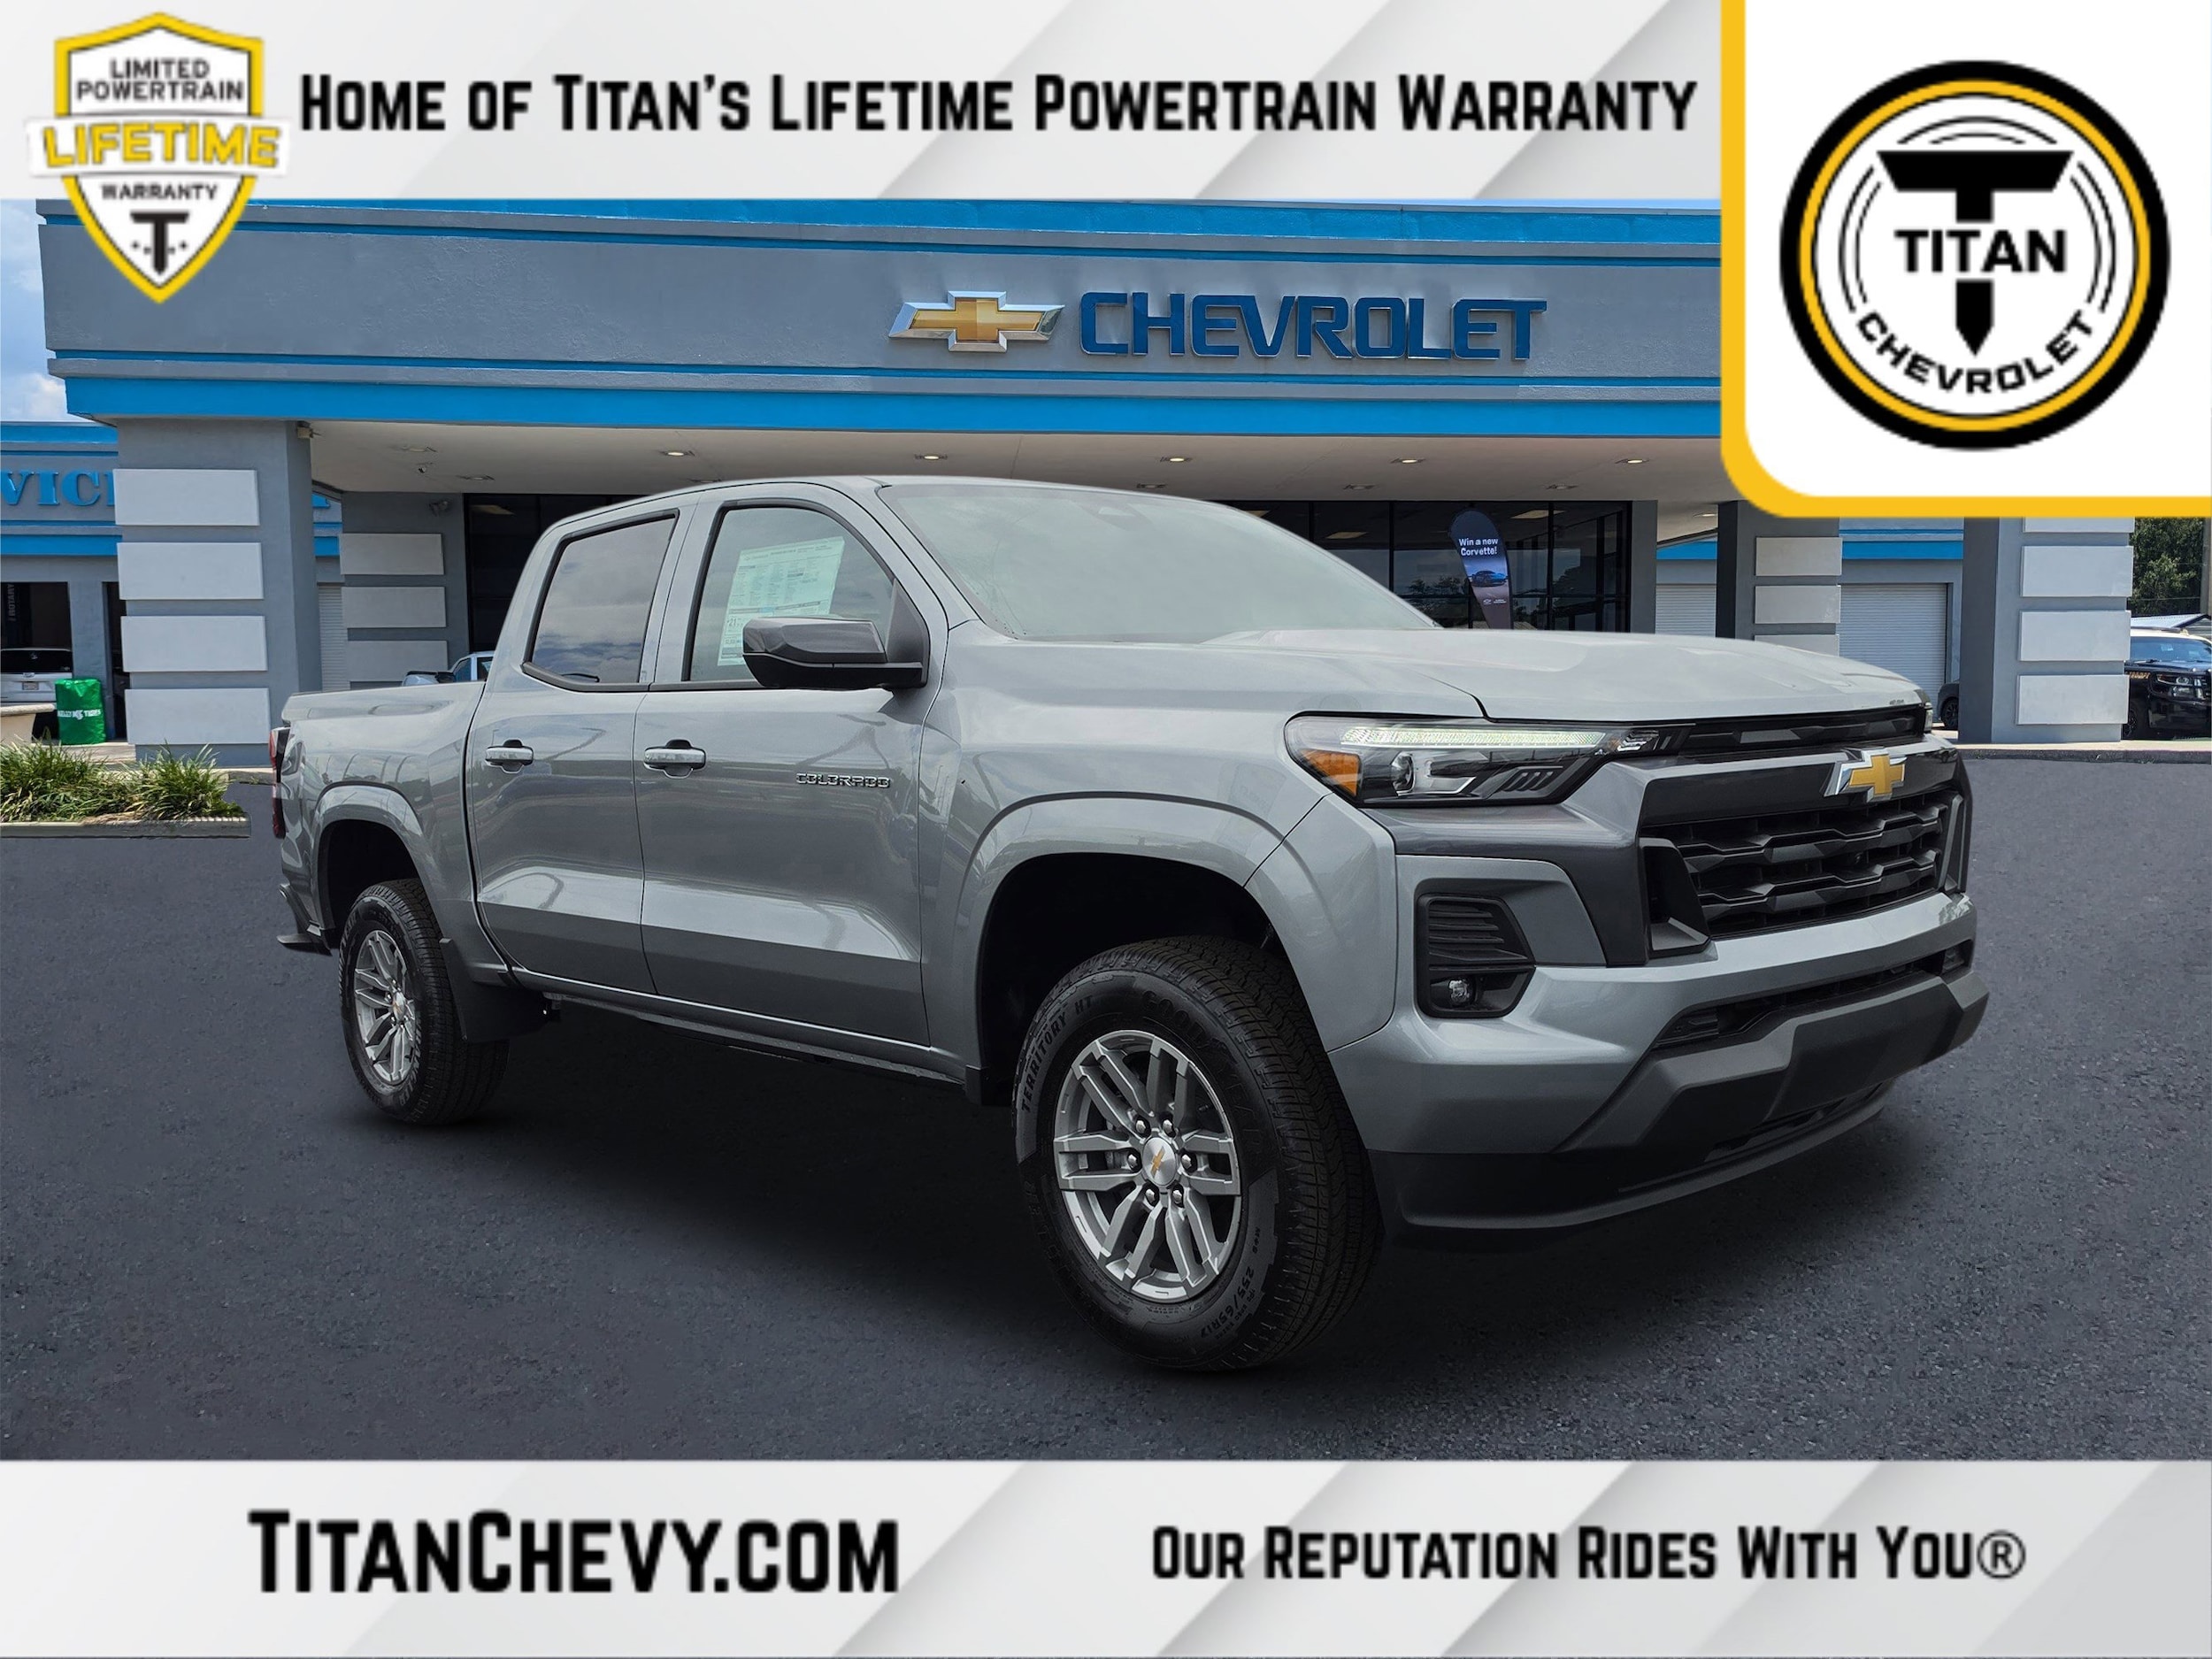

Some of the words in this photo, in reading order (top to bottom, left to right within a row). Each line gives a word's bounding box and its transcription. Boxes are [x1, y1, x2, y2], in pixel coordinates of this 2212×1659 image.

[1080, 291, 1548, 360] CHEVROLET
[1461, 546, 1498, 556] Corvette!
[795, 772, 891, 788] COLORADO
[1021, 1011, 1067, 1113] TERRITORY
[1074, 995, 1094, 1014] HT
